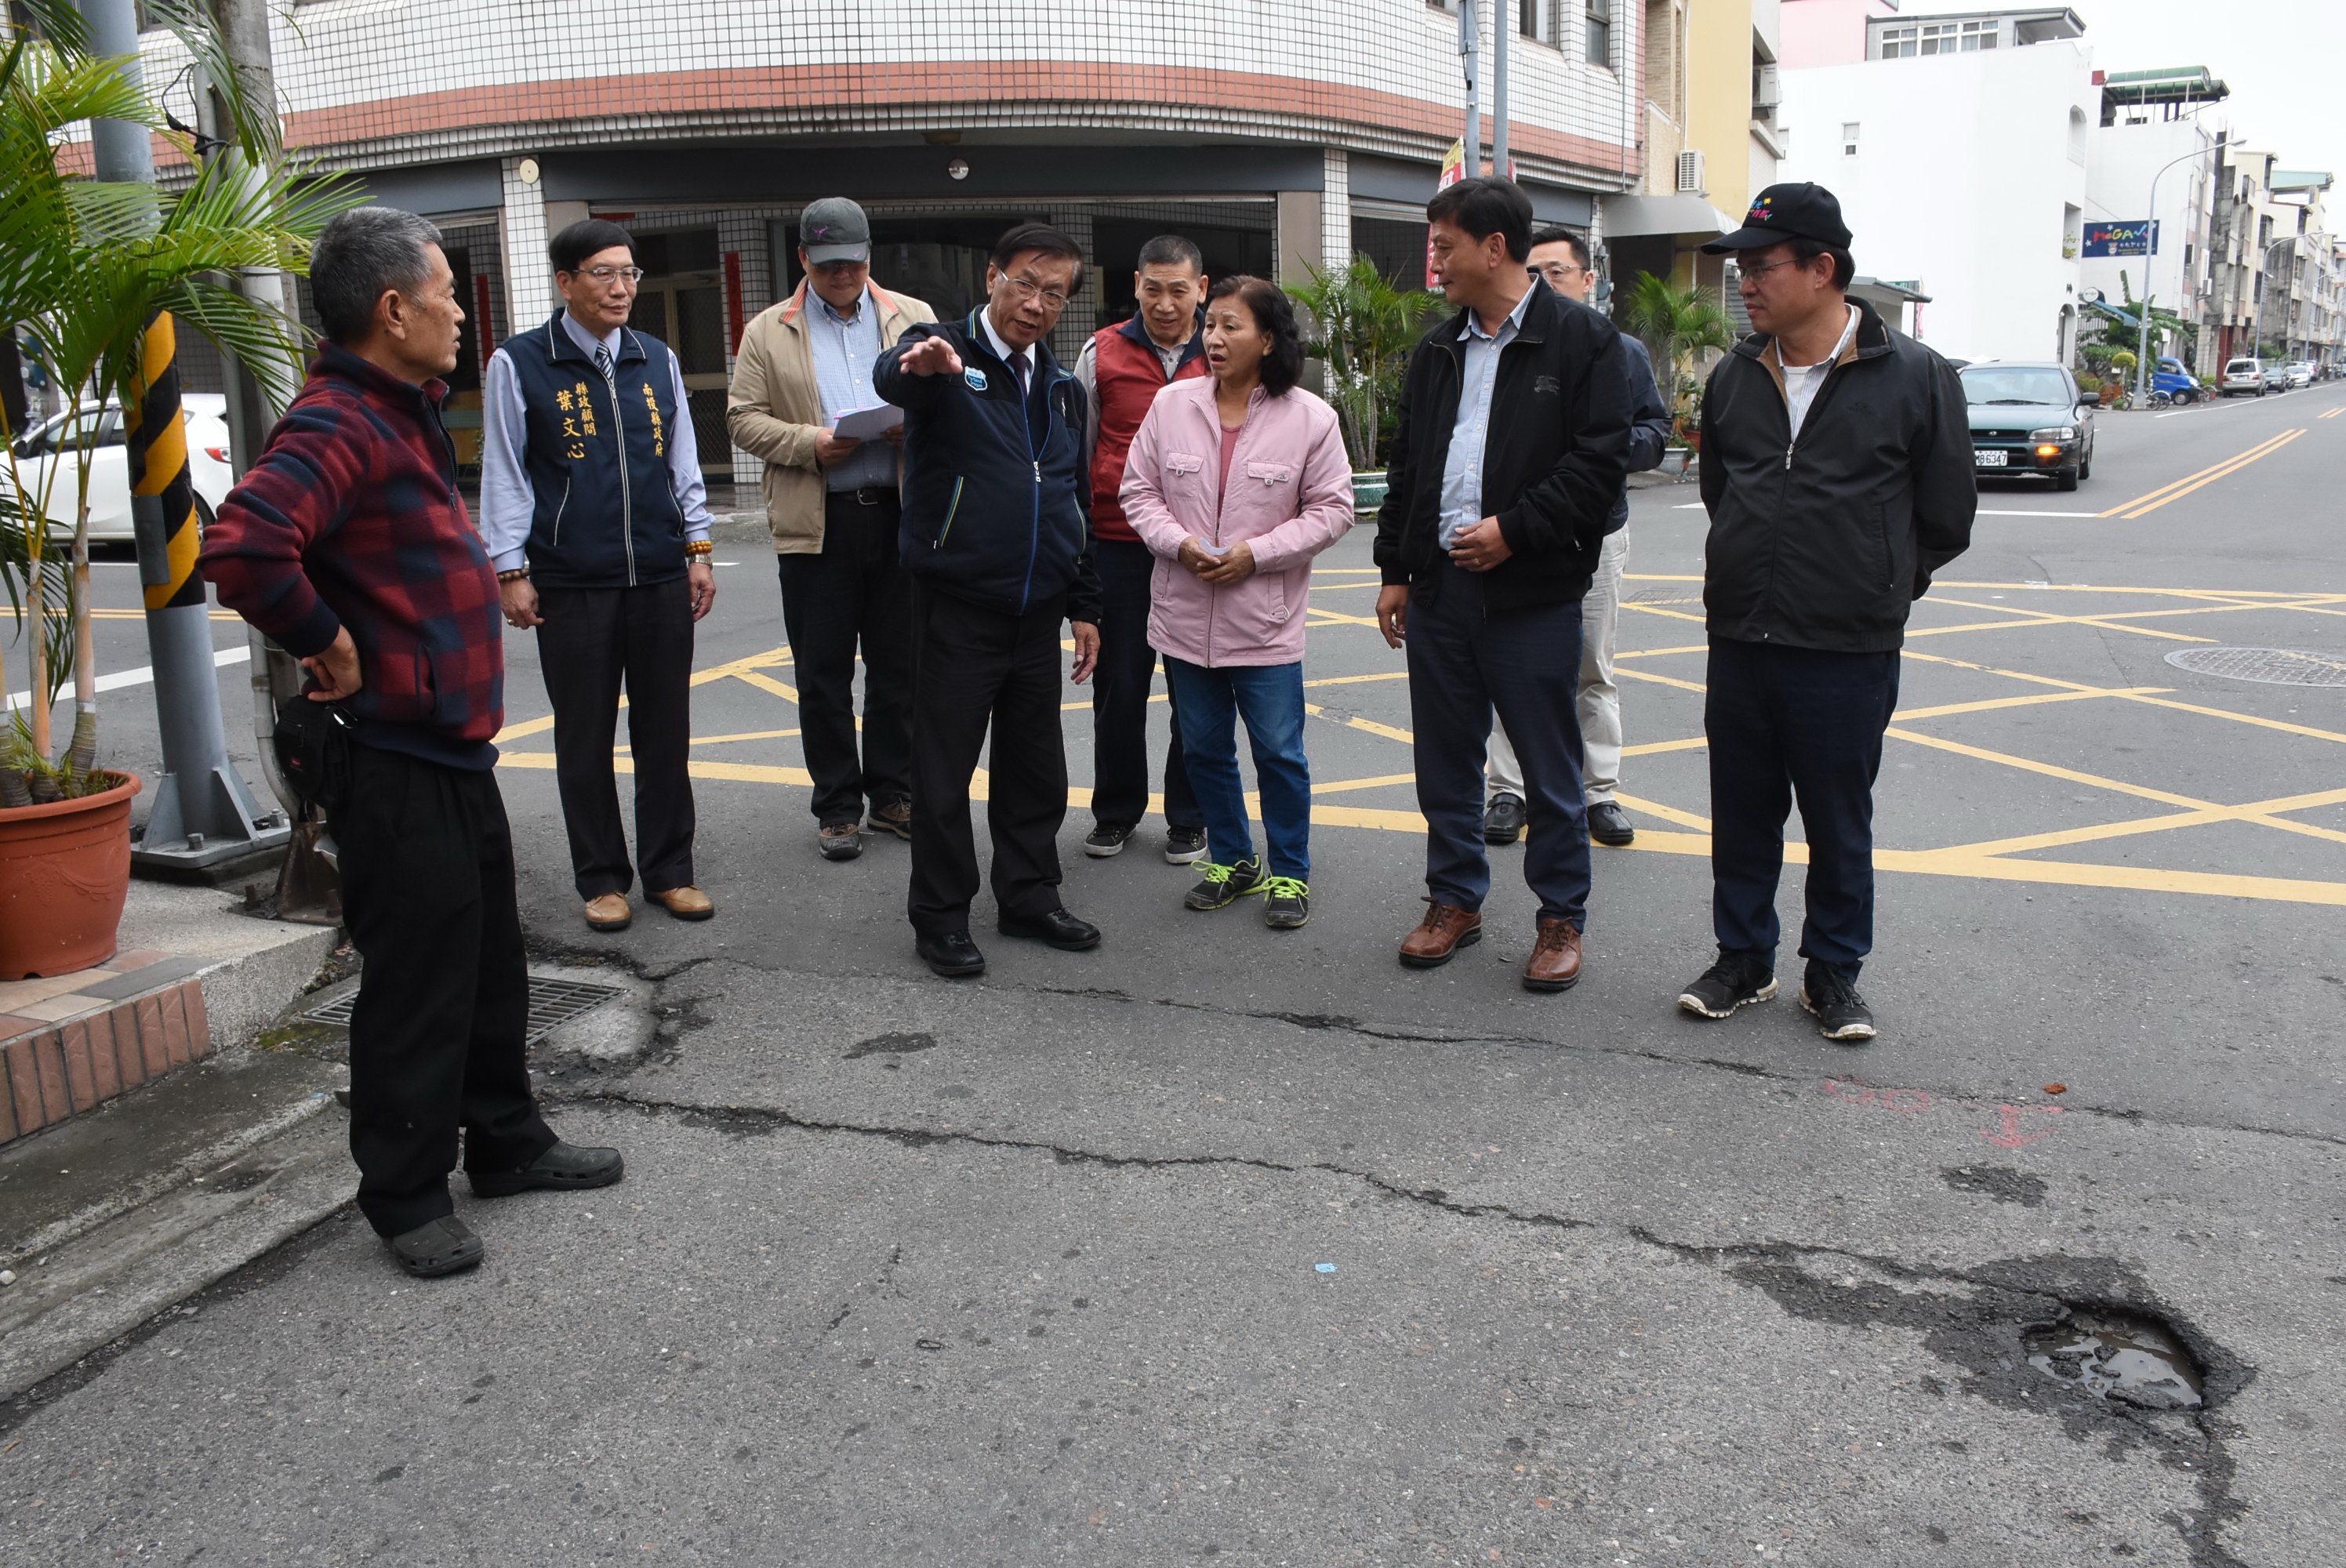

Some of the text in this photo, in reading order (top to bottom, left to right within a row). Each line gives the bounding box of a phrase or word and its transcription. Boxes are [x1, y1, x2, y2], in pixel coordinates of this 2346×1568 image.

[556, 390, 585, 459] 葉文心
[576, 381, 596, 436] 縣政顧問
[643, 383, 663, 457] 南投縣政府
